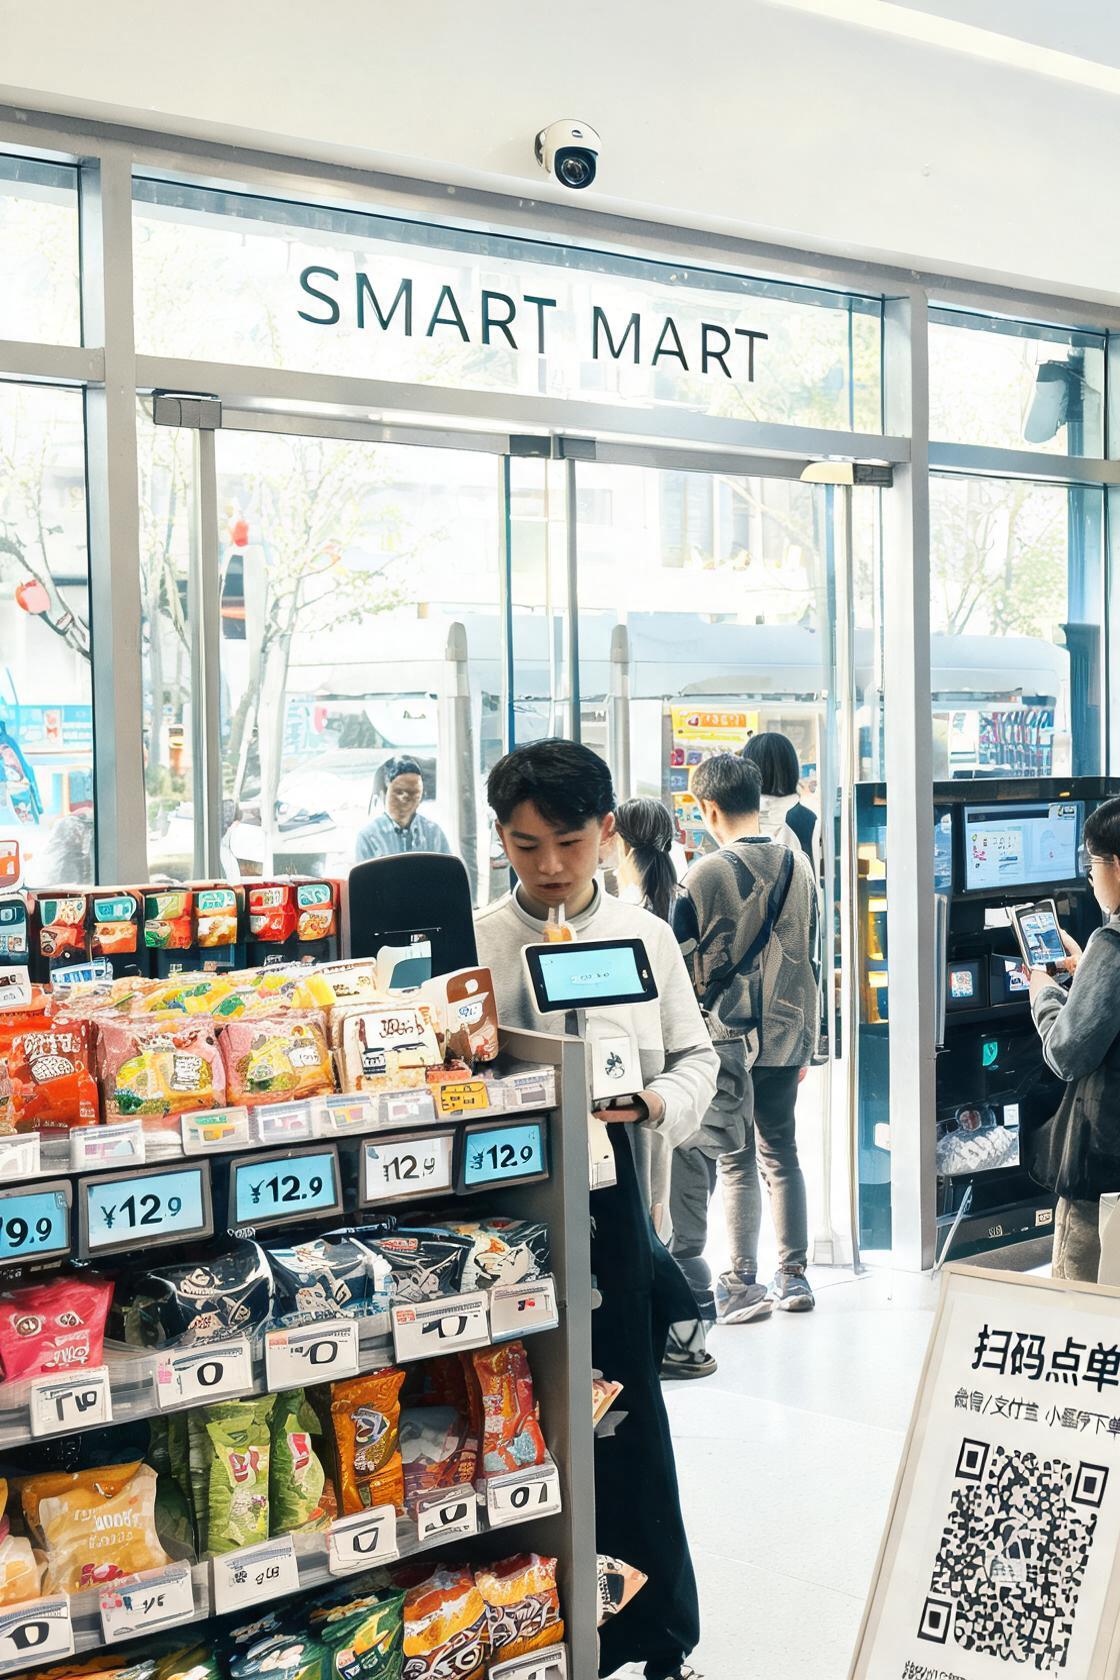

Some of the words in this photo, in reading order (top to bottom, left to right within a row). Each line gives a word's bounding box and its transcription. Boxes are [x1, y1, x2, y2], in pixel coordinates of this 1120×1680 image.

[298, 265, 557, 354] SMART
[592, 305, 769, 383] MART
[249, 1175, 323, 1204] ¥12.9
[0, 1216, 52, 1248] 9.9
